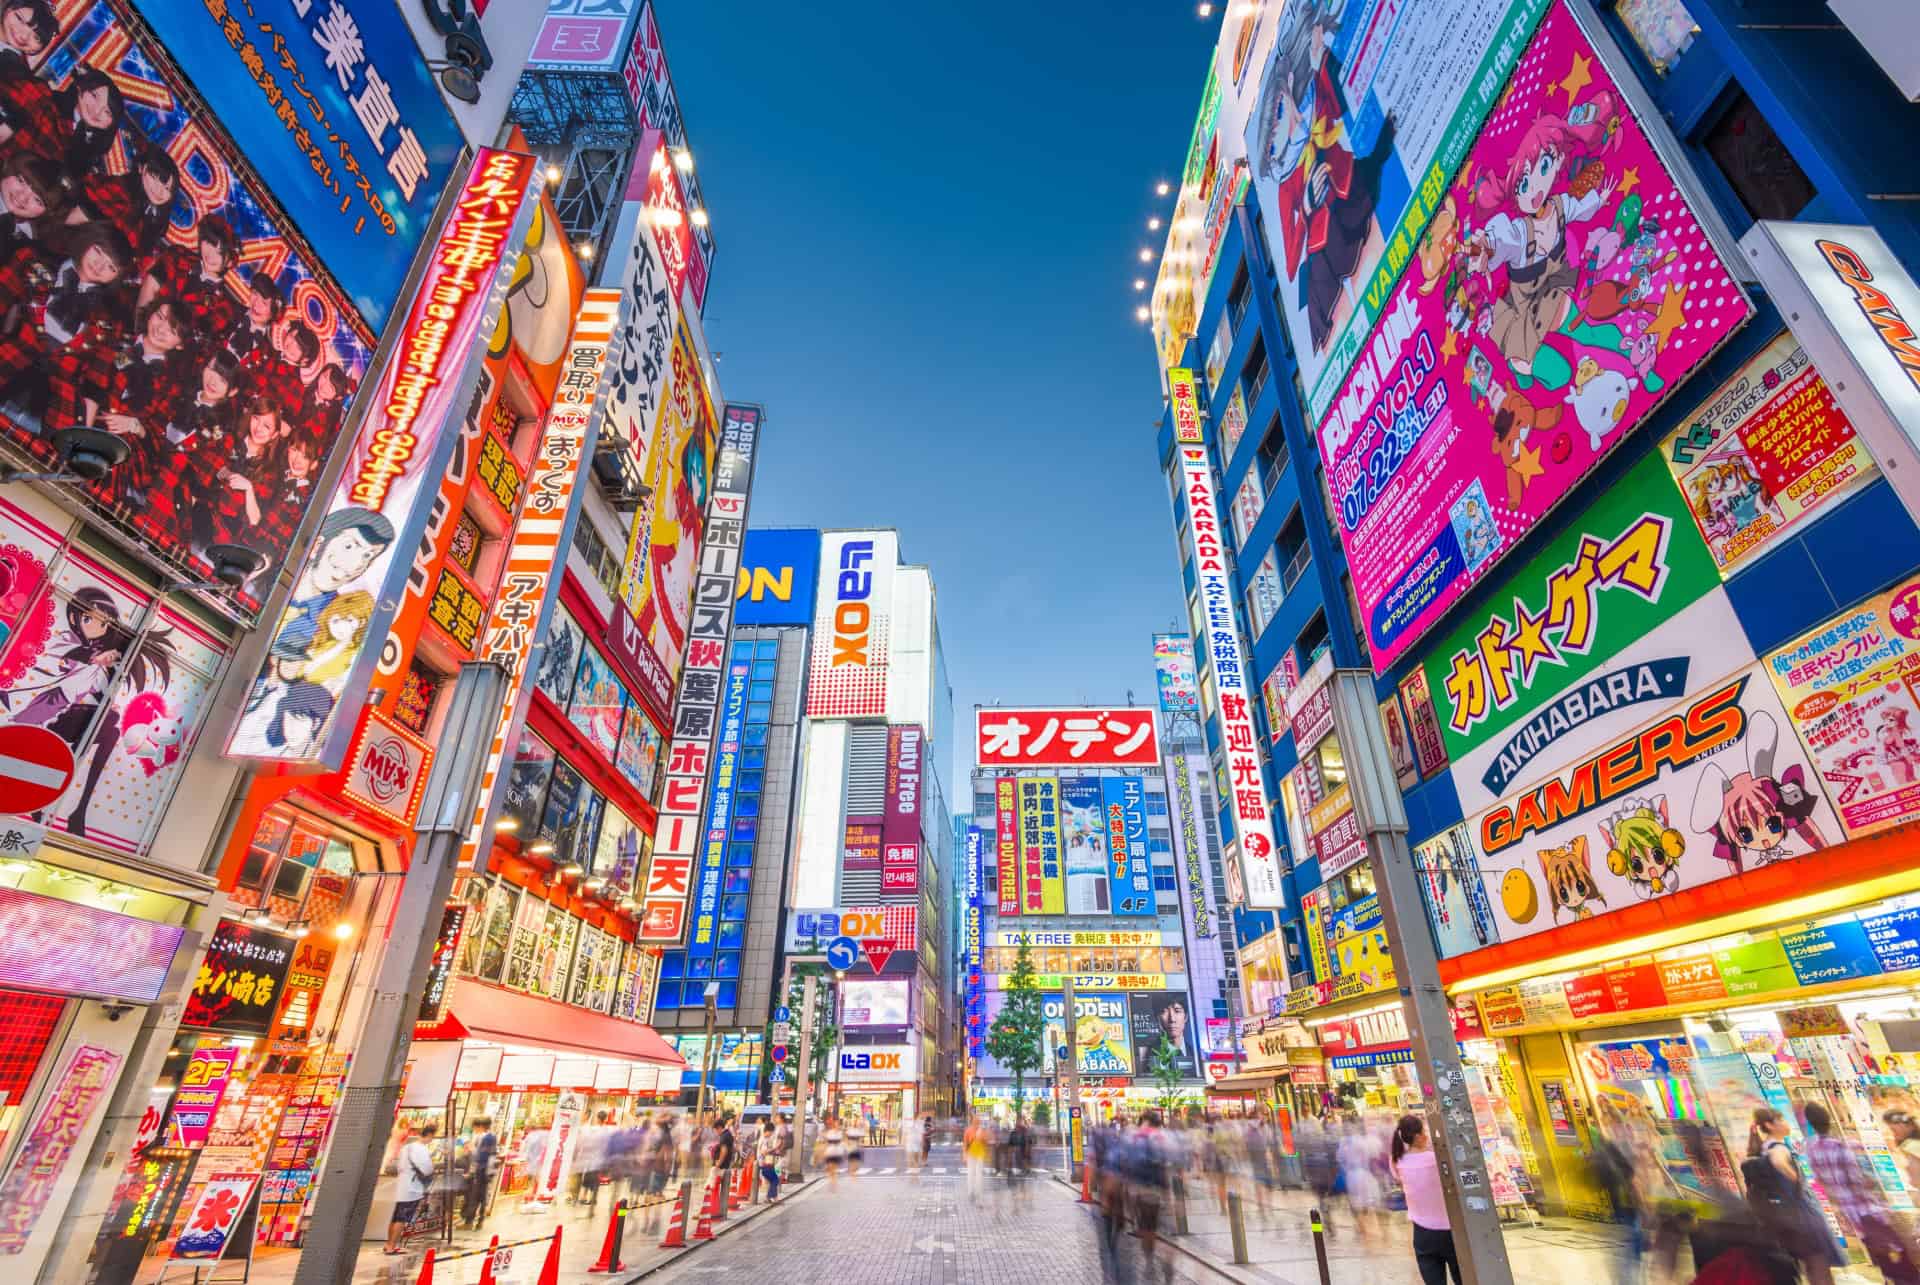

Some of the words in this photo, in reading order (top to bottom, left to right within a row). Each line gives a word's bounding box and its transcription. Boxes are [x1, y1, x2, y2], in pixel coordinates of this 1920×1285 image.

[1816, 239, 1920, 391] GAM
[563, 347, 602, 405] 買取り
[738, 409, 760, 464] HOBBY
[1174, 382, 1200, 440] まんが喫茶
[716, 408, 742, 490] PARADISE
[1185, 471, 1223, 571] TAKARADA
[1211, 630, 1243, 689] 免税商店
[898, 730, 921, 770] Duty
[981, 710, 1152, 759] オノデン
[1499, 666, 1662, 782] AKIHABARA
[1220, 692, 1267, 821] 歓迎光臨
[1481, 681, 1743, 856] GAMERS
[898, 773, 919, 814] Free
[1124, 781, 1144, 840] エアコン
[0, 828, 36, 853] 除く
[967, 832, 980, 899] Panasonic
[968, 905, 980, 966] ONODEN
[1036, 933, 1071, 945] FREE
[1074, 975, 1115, 988] エアコン
[185, 1060, 229, 1086] 2F
[1044, 1059, 1128, 1074] AABARA
[190, 1187, 241, 1233] 氷
